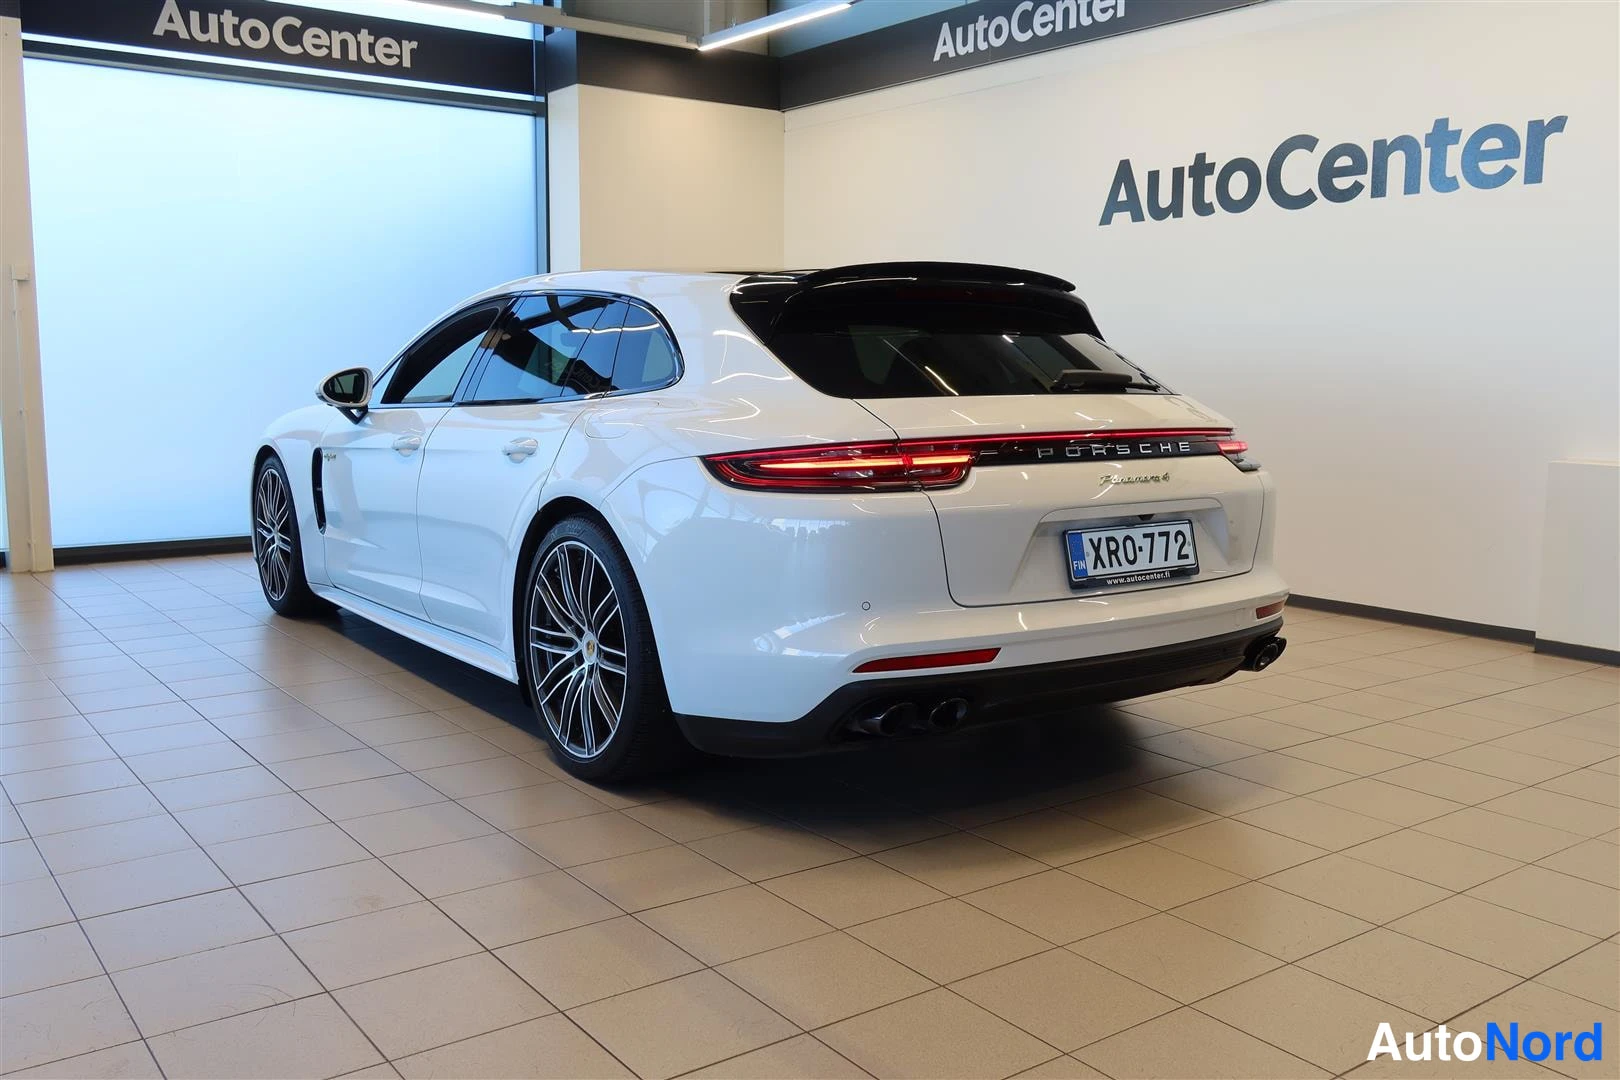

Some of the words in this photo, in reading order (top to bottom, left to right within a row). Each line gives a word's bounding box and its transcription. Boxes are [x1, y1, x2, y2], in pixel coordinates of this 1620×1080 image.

[152, 0, 418, 68] AutoCenter
[1098, 115, 1568, 226] AutoCenter
[1037, 441, 1190, 458] PORSCHE
[1089, 530, 1190, 570] XRO-772
[1073, 560, 1086, 571] FIN
[1106, 572, 1171, 585] www.autocenter.fi
